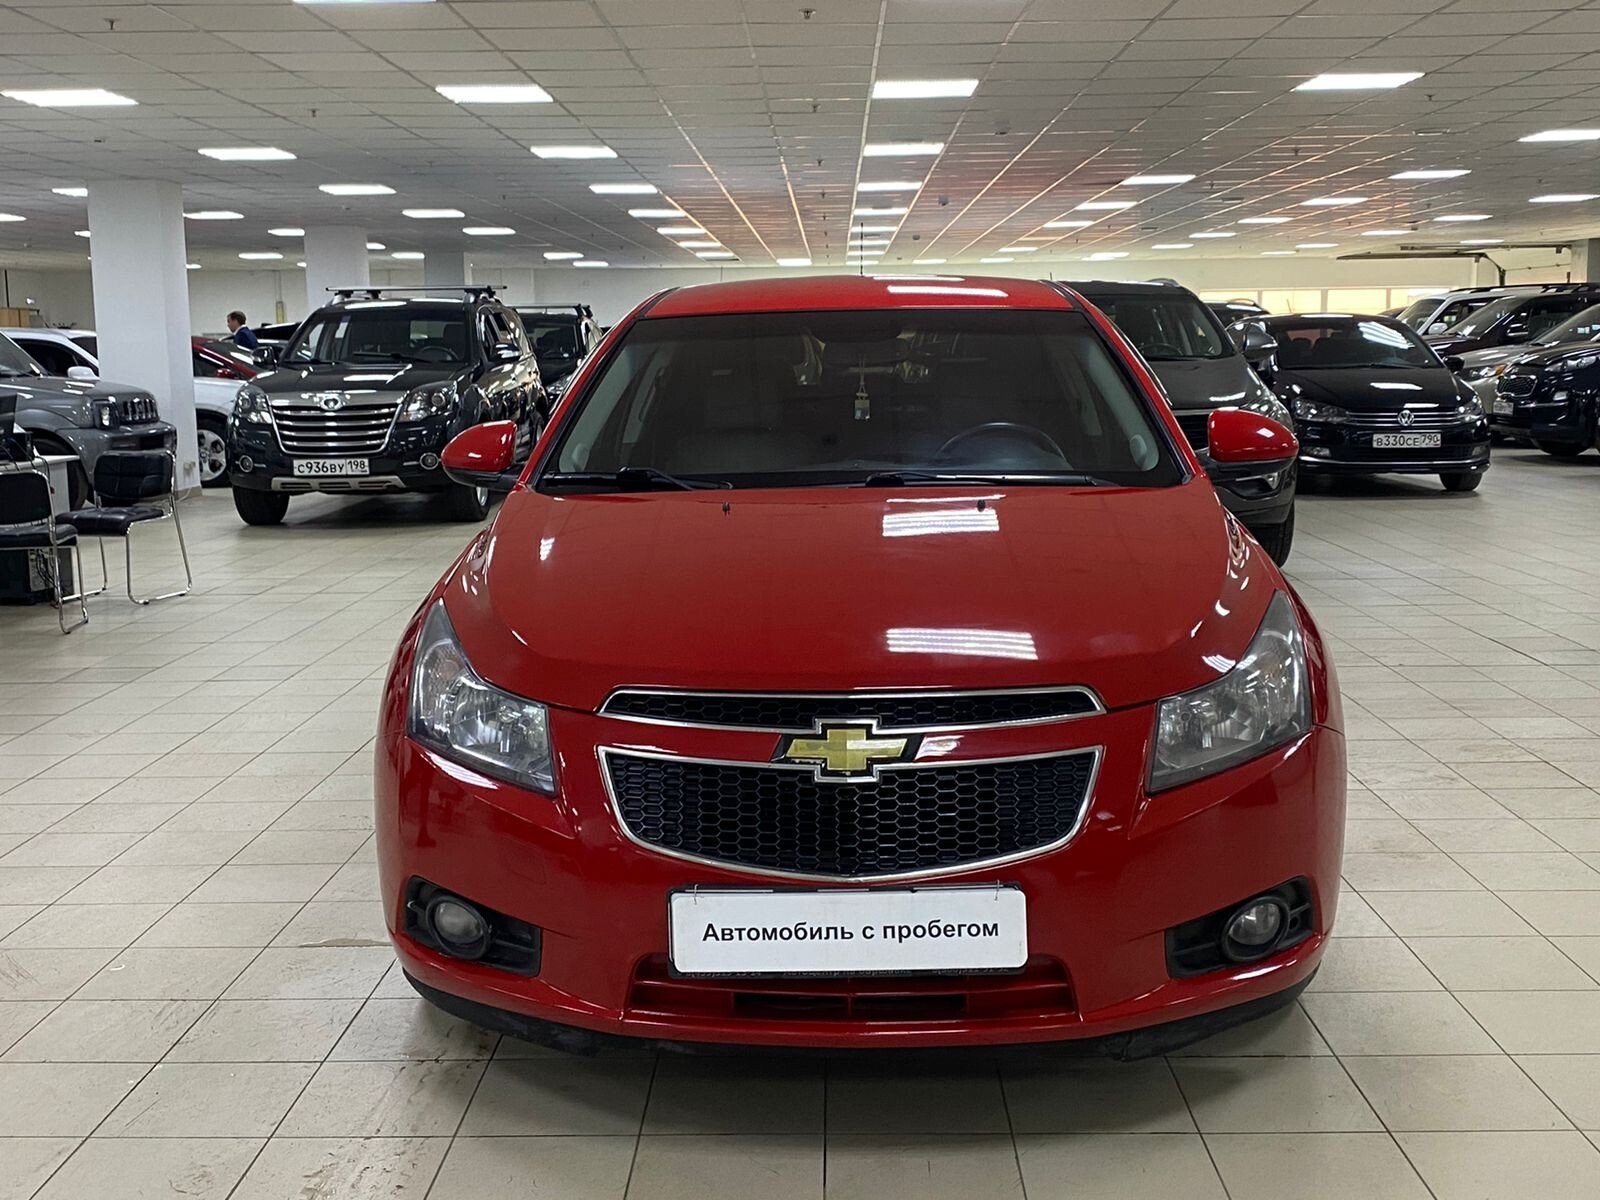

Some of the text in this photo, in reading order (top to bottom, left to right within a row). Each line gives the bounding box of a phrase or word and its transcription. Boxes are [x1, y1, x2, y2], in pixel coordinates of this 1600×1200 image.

[348, 460, 365, 469] 198
[703, 920, 998, 943] Автомобиль с пробегом
